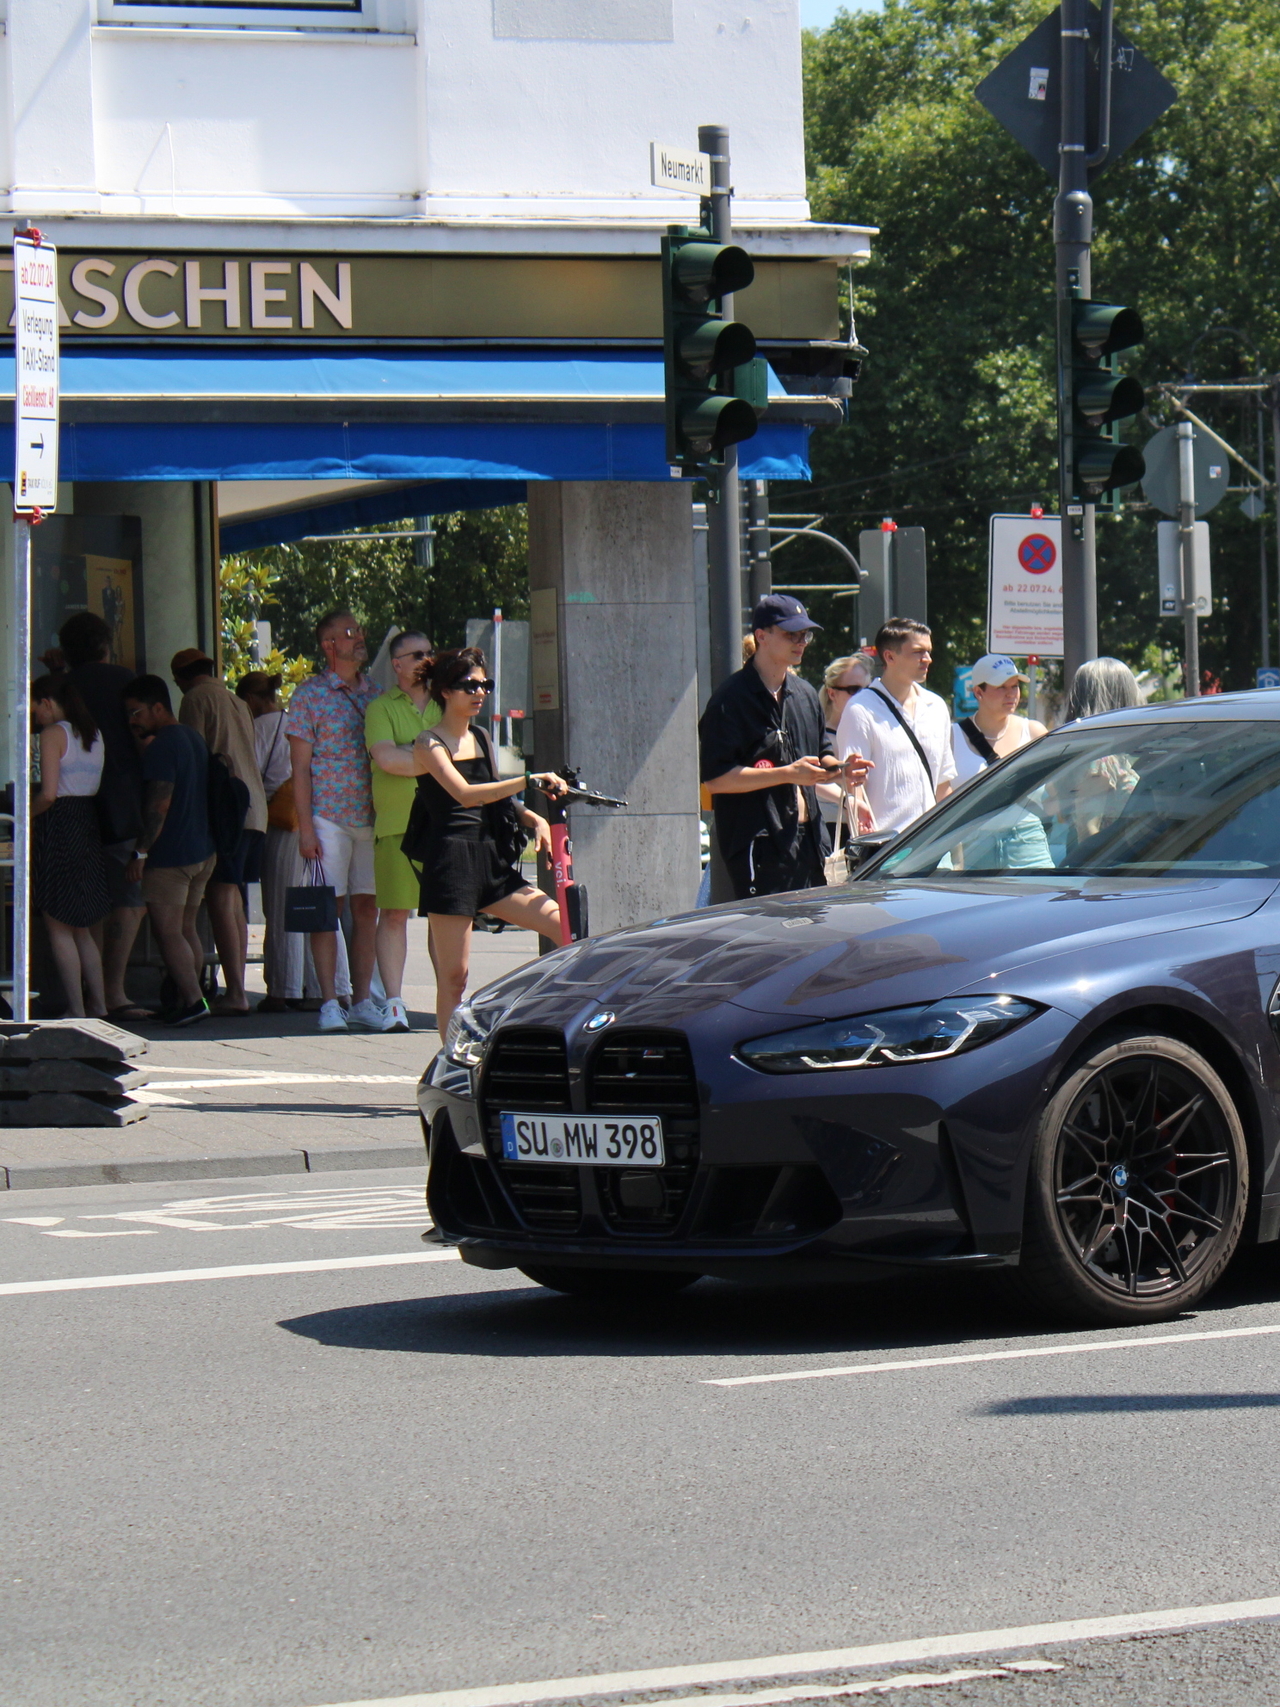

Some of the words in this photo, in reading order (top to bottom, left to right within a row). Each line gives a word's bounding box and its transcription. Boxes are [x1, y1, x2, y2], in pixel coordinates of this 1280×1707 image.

[661, 151, 704, 185] Neumarkt
[21, 261, 28, 284] ab
[22, 309, 54, 342] Verlegung
[22, 346, 55, 373] TAXI-Stand
[1002, 583, 1014, 592] ab
[1117, 1038, 1159, 1054] PIRELLI
[507, 1141, 514, 1152] D
[516, 1120, 549, 1157] SU
[563, 1122, 598, 1158] MW
[604, 1123, 657, 1160] 398
